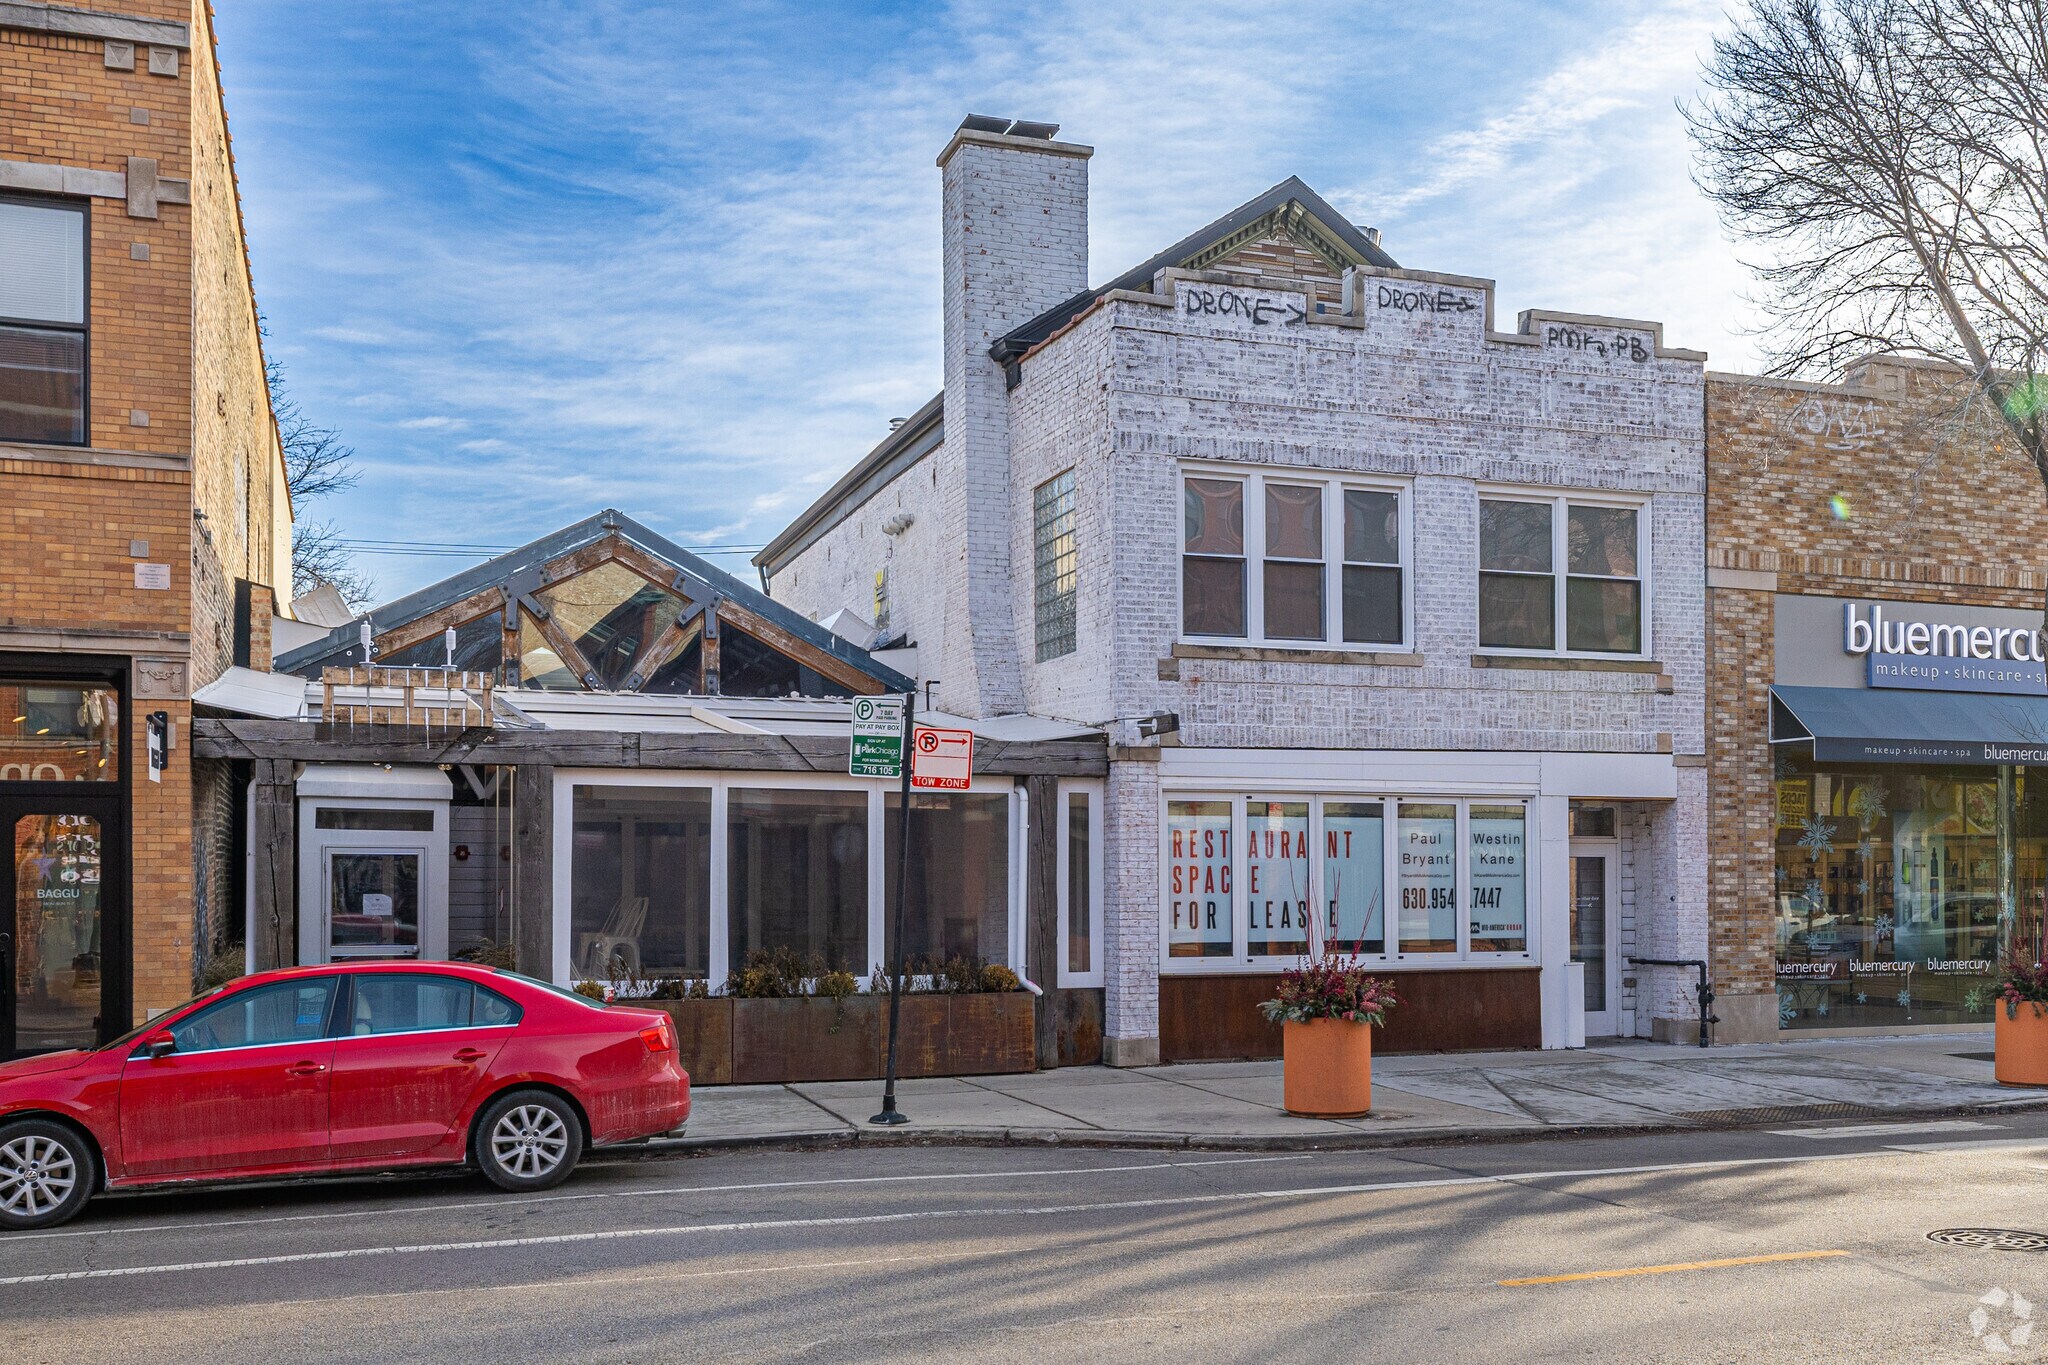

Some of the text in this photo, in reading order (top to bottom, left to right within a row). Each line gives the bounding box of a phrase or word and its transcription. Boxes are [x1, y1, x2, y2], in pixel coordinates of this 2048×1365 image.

[1876, 662, 1939, 680] makeup
[1954, 665, 2022, 682] skincare
[861, 746, 899, 757] ParkChicago
[1864, 746, 1971, 758] makeup skincare spa
[862, 765, 877, 774] 716
[879, 766, 893, 775] 105
[916, 777, 967, 788] TOW ZONE
[1410, 833, 1441, 844] Paul
[1473, 833, 1521, 845] Westin
[1402, 853, 1450, 867] Bryant
[1480, 853, 1515, 865] Kane
[37, 888, 80, 899] BAGGU
[1173, 901, 1217, 930] FOR
[1849, 958, 1915, 974] bluemercury
[1927, 957, 1991, 972] bluemercury
